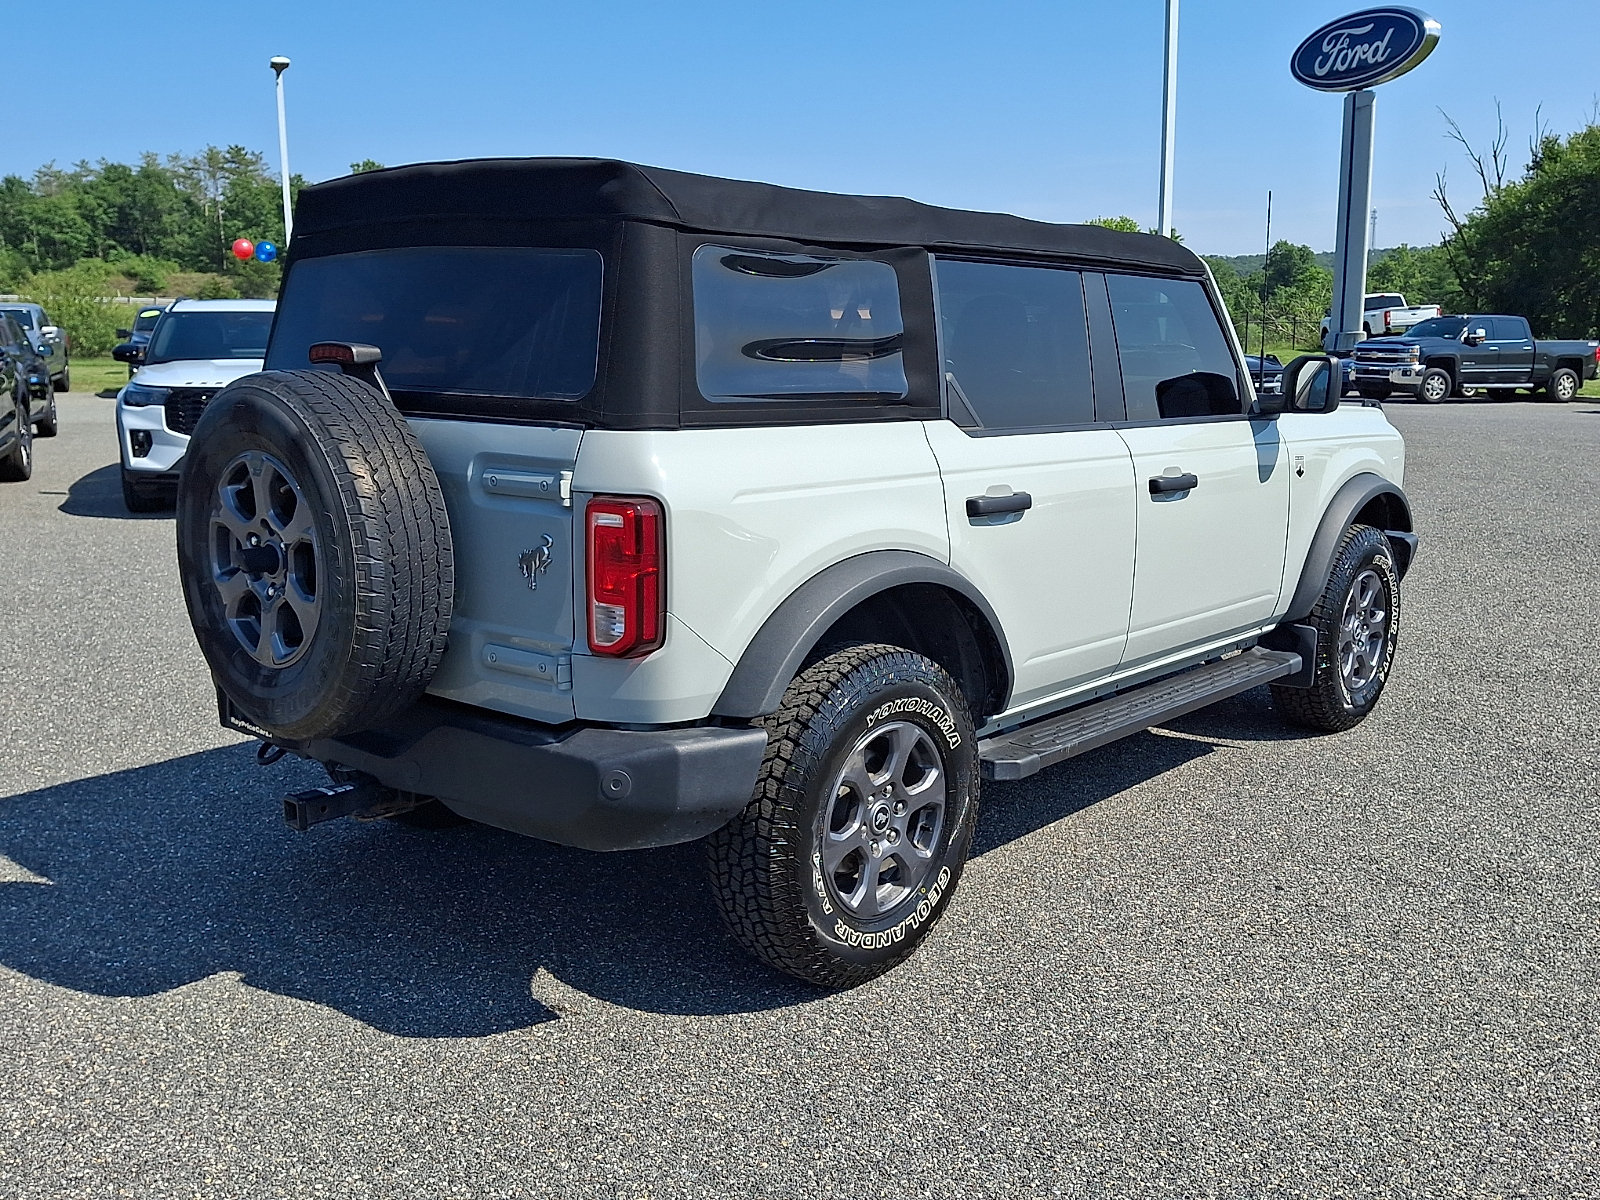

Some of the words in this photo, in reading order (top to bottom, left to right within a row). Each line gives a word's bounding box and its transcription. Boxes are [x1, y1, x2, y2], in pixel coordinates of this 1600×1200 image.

[1314, 23, 1395, 77] Ford
[865, 697, 963, 750] YOKOHAMA
[834, 864, 952, 950] GEOLANDAR
